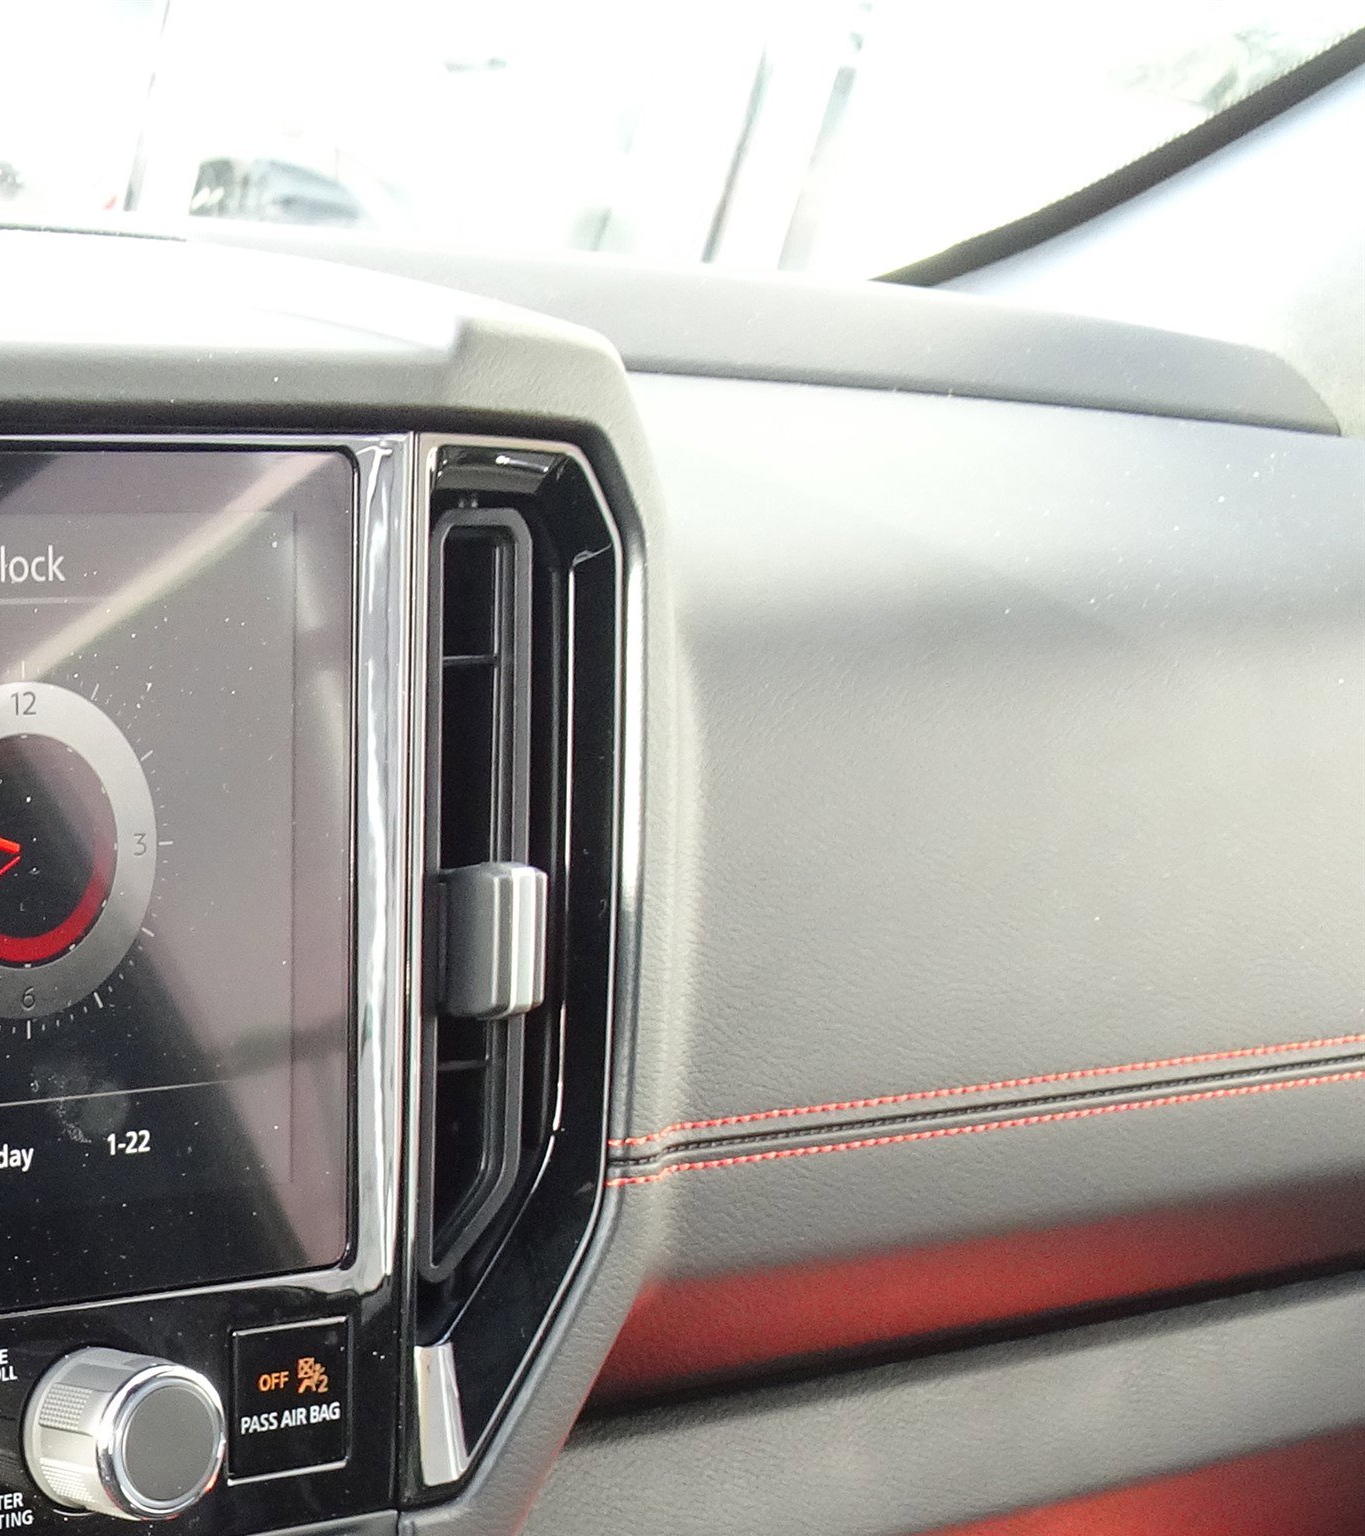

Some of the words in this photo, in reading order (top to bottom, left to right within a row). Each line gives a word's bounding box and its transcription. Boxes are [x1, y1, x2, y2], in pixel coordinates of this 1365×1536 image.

[9, 691, 38, 718] 12
[133, 832, 147, 857] 3
[21, 985, 36, 1011] 6
[106, 1130, 151, 1158] 1-22
[258, 1371, 290, 1392] OFF
[240, 1411, 280, 1435] PASS
[280, 1406, 308, 1429] AIR
[309, 1400, 342, 1424] BAG
